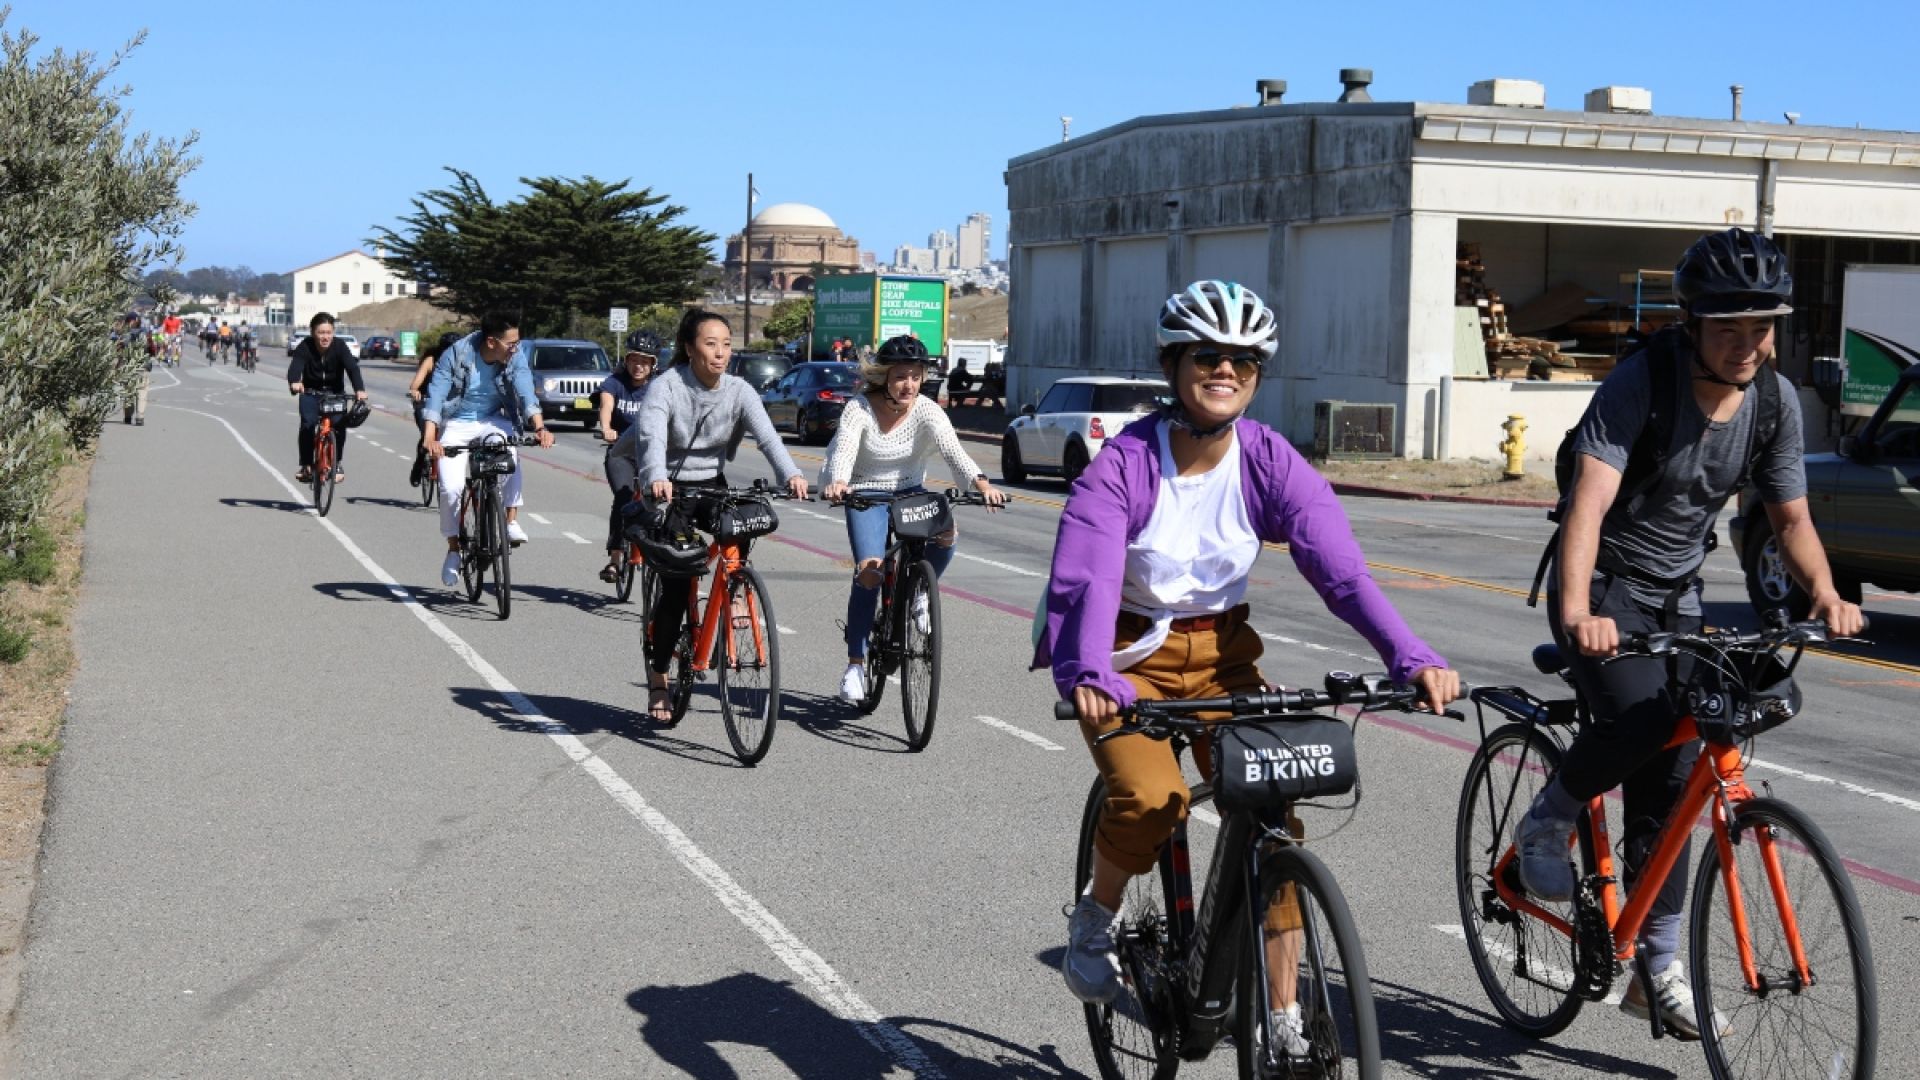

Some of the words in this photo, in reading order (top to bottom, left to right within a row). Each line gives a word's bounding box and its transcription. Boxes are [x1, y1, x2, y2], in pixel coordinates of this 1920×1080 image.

[882, 281, 909, 291] STORE
[882, 290, 905, 300] GEAR
[881, 300, 902, 308] BIKE
[903, 300, 941, 310] RENTALS
[612, 320, 626, 329] 25
[902, 506, 940, 523] BIKING
[1244, 744, 1332, 762] UNLIMTED
[1245, 757, 1335, 783] BIKING
